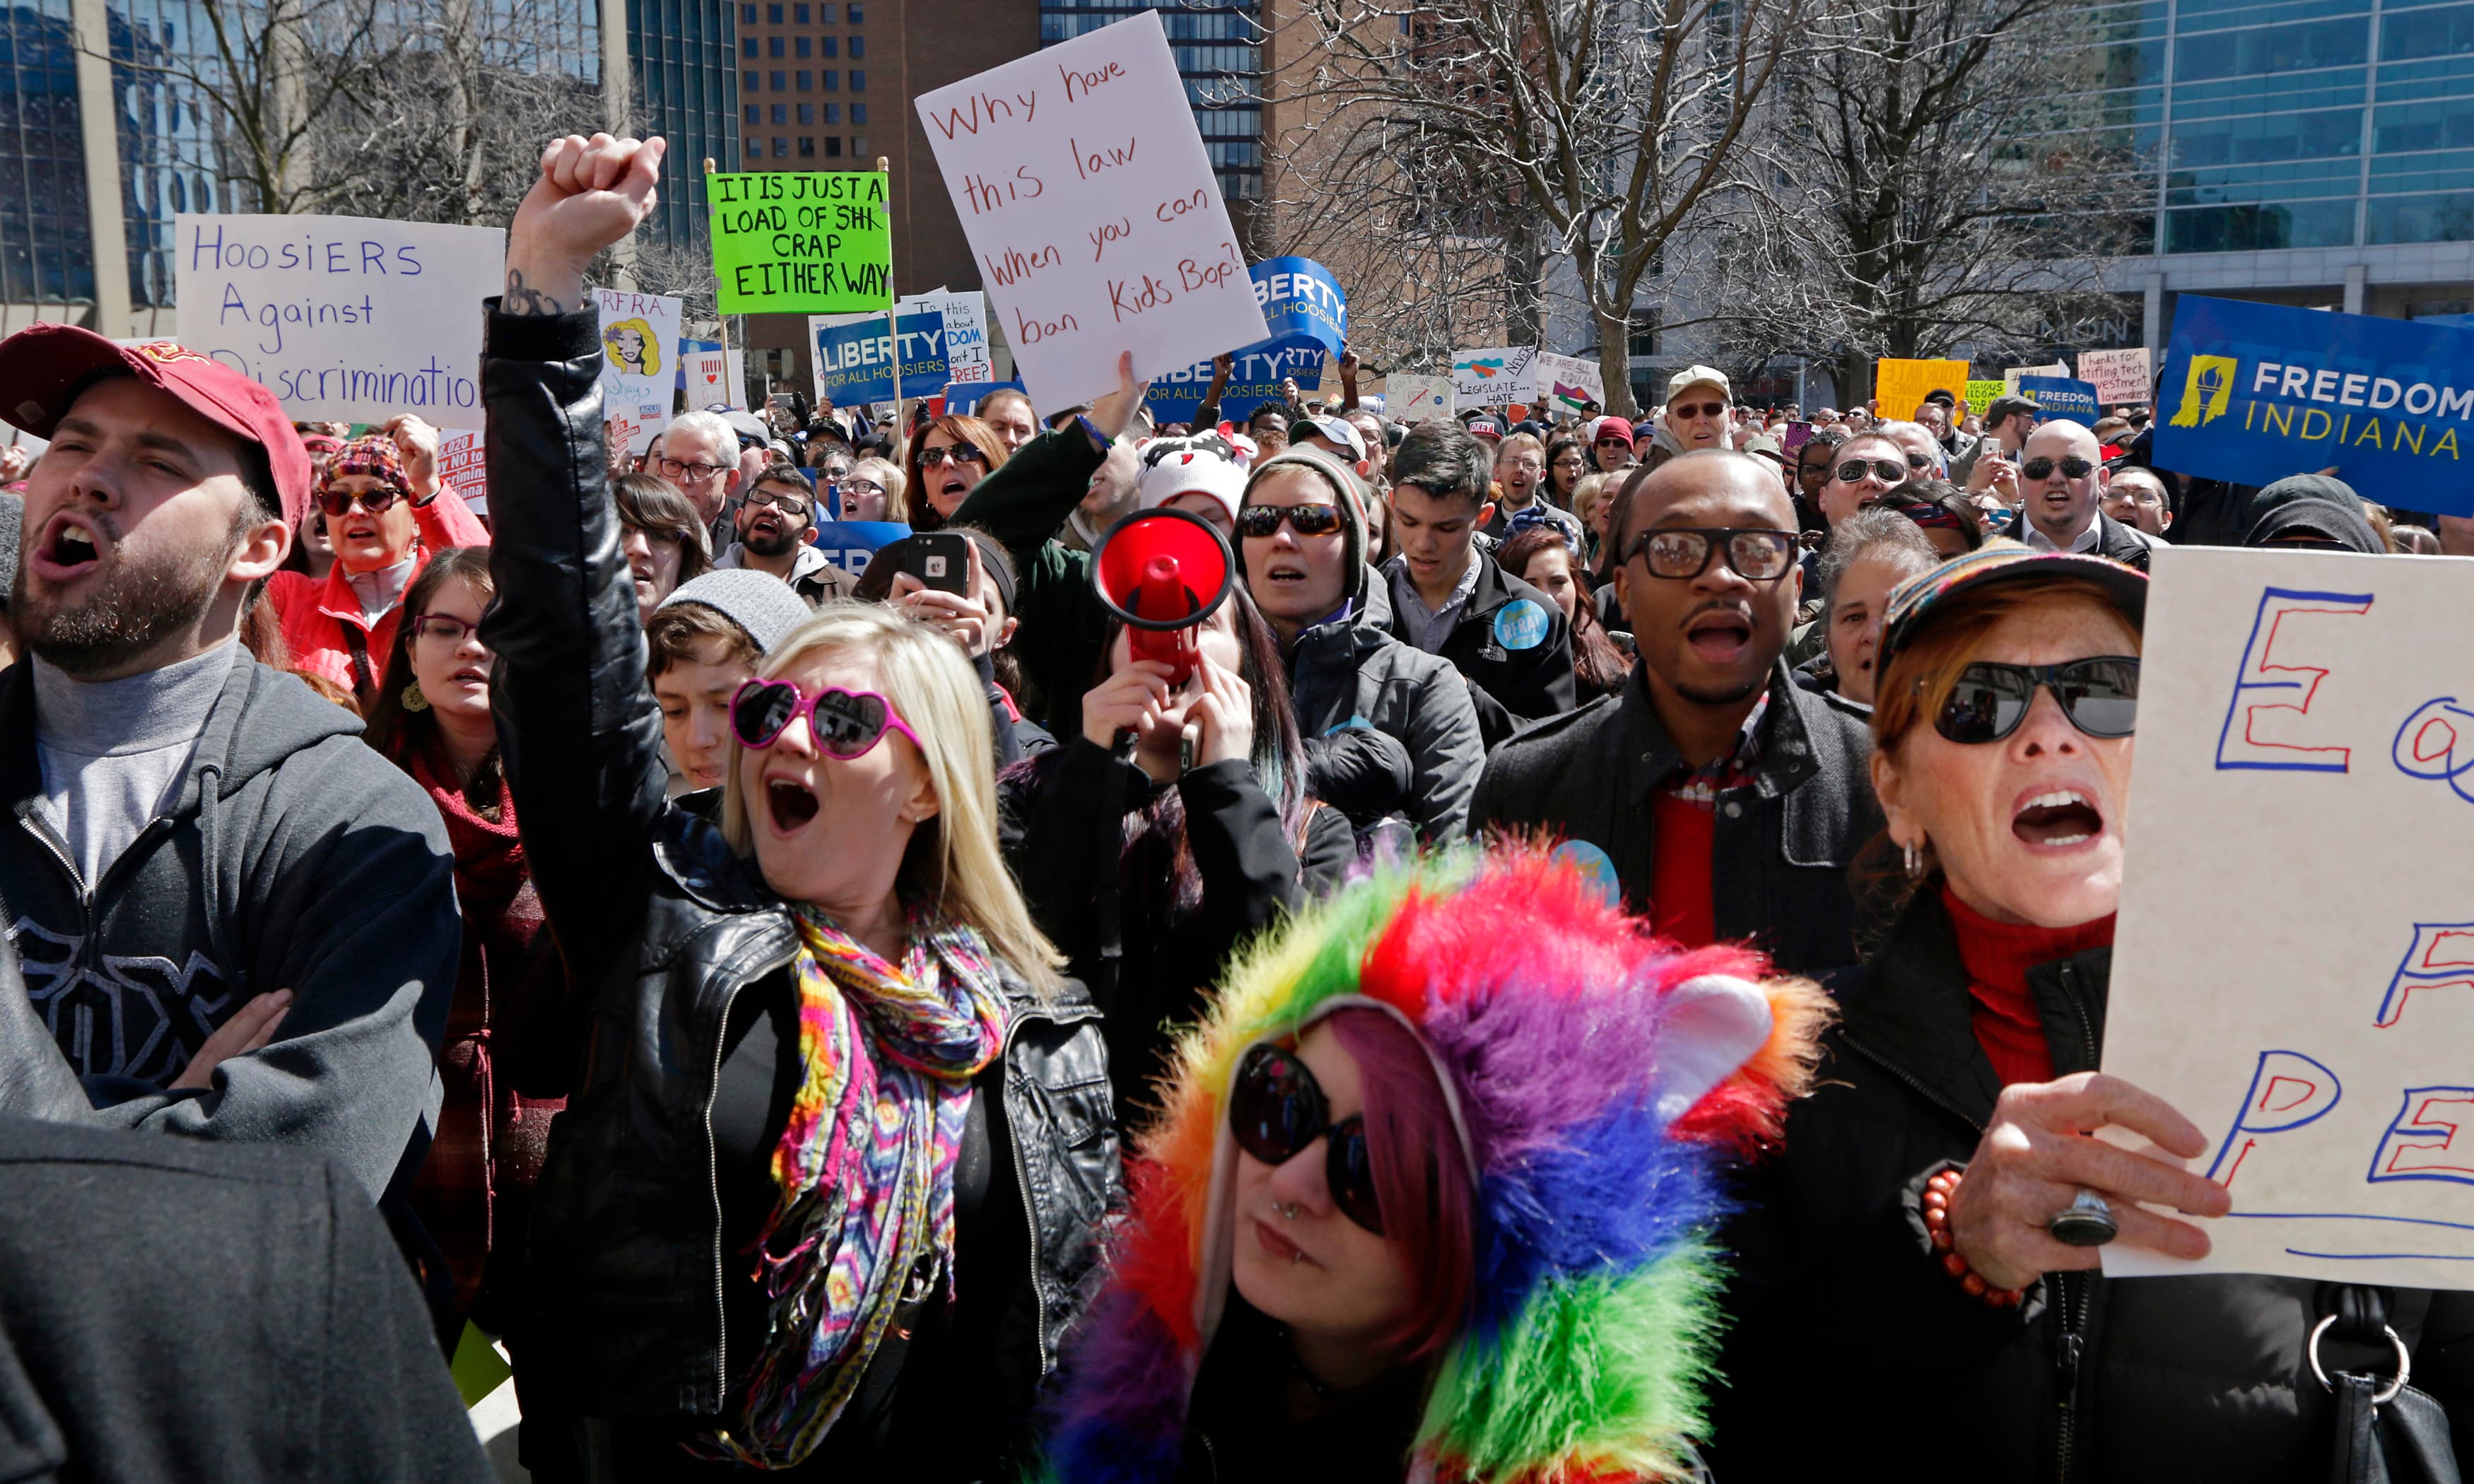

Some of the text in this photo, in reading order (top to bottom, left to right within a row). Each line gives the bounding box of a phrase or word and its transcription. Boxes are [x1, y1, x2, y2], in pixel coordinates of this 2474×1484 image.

[930, 61, 1125, 140] Why have
[963, 137, 1135, 214] this law
[717, 176, 884, 203] IT IS JUST A
[723, 206, 786, 234] LOAD
[798, 206, 826, 230] OF
[1089, 218, 1130, 261] you
[1156, 189, 1207, 222] can
[773, 234, 841, 259] CRAP
[735, 261, 889, 298] EITHER WAY
[1016, 242, 1241, 345] ban Kids Bop?
[1255, 272, 1347, 324] BERTY
[220, 283, 373, 353] Against
[945, 302, 970, 315] this
[1265, 306, 1279, 322] LL
[946, 317, 974, 329] about
[822, 329, 942, 372] LIBERTY
[948, 347, 983, 363] on't I
[1505, 346, 1533, 375] NEVER
[2080, 351, 2139, 366] Thanks for
[826, 375, 846, 388] FOR
[848, 370, 870, 384] ALL
[873, 359, 945, 380] HOOSIERS
[1555, 359, 1573, 370] ARE
[2080, 364, 2146, 380] stifling tech
[210, 349, 483, 408] Discriminatio
[1966, 382, 2003, 391] IGIOUS
[2097, 375, 2150, 390] vestment,
[1146, 388, 1169, 401] OR
[1174, 387, 1201, 399] ALL
[1487, 394, 1516, 404] HATE
[1965, 390, 1998, 399] EEDOM
[2039, 391, 2094, 404] FREEDOM
[2253, 362, 2474, 421] FREEDOM
[2039, 401, 2094, 414] INDIANA
[2245, 401, 2460, 460] INDIANA
[451, 452, 468, 468] NO
[471, 451, 483, 463] to
